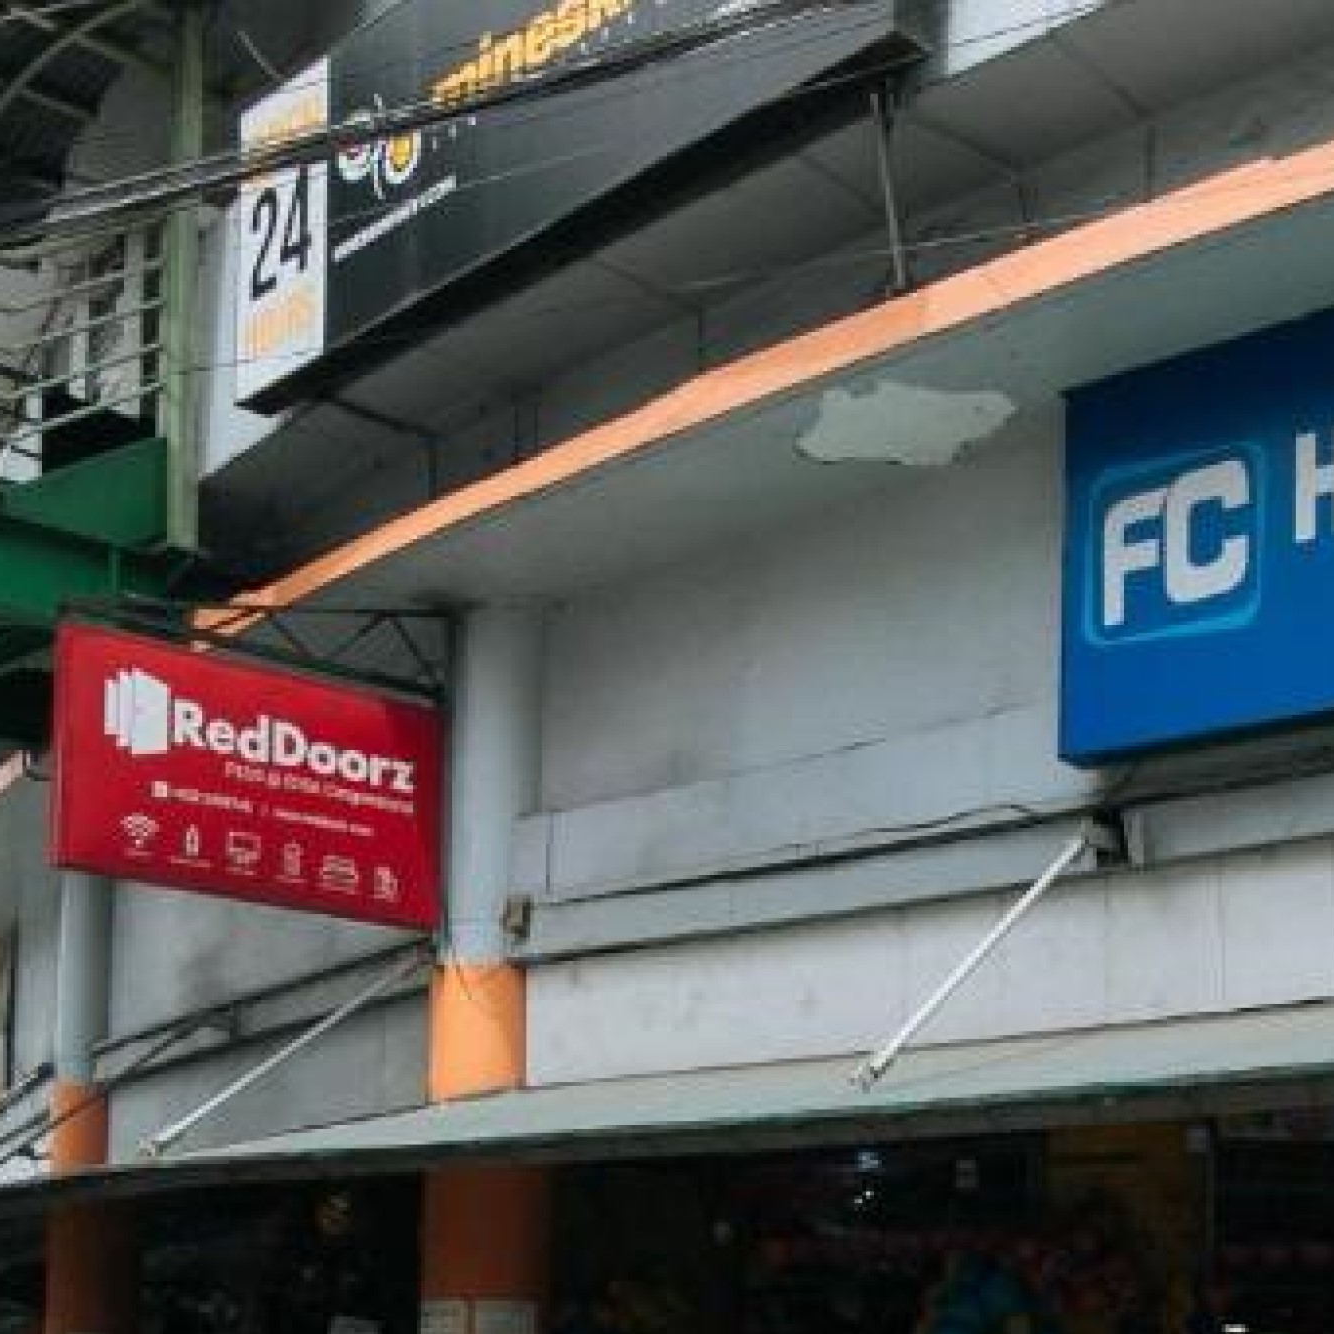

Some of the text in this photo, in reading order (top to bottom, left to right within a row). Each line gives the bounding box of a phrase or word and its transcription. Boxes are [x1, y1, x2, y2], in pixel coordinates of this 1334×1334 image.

[250, 161, 313, 299] 24
[1102, 460, 1251, 627] FC
[173, 699, 417, 793] RedDoorz
